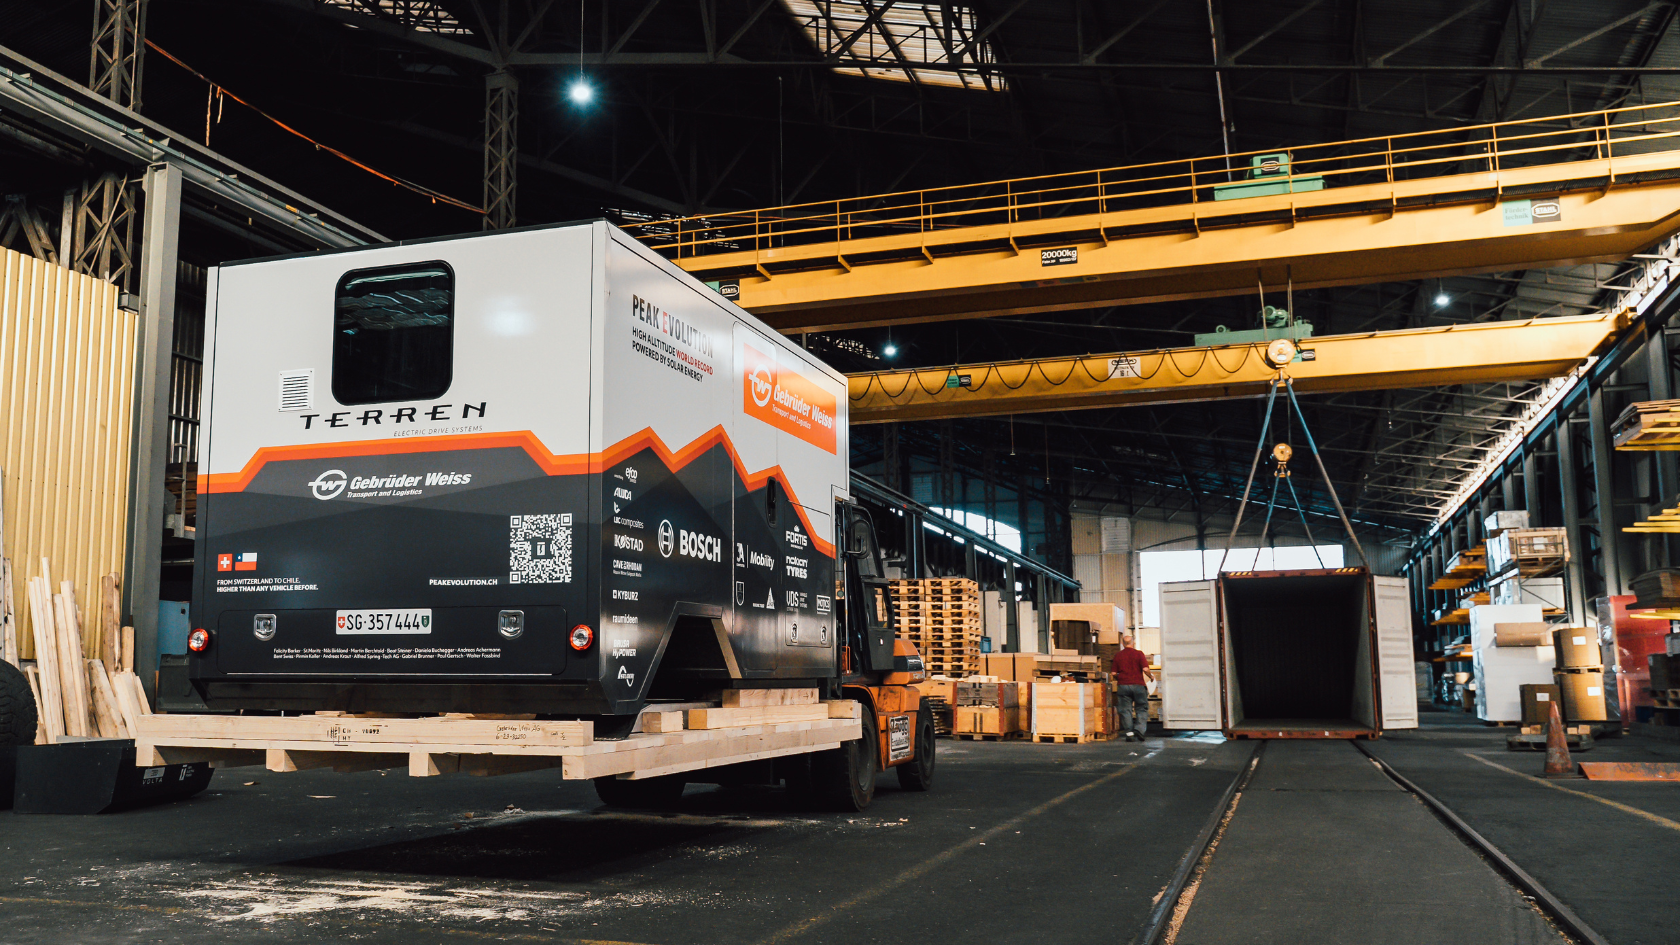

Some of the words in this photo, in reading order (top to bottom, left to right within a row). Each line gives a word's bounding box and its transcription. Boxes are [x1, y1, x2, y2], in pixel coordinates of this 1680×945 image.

[1534, 206, 1557, 214] STAHL
[1042, 249, 1077, 259] 20000kg
[632, 293, 659, 329] PEAK
[662, 311, 713, 358] EVOLUTION
[632, 326, 647, 342] HIGH
[647, 334, 676, 357] ALLTITUDE
[676, 348, 694, 366] WORLD
[694, 356, 714, 376] RECORD
[632, 340, 659, 361] POWERED
[659, 353, 667, 365] BY
[666, 357, 684, 374] SOLAR
[684, 366, 703, 382] ENERGY
[773, 384, 811, 417] Gebrüder
[811, 404, 833, 429] Weiss
[300, 401, 487, 430] TERREN
[772, 403, 789, 419] Transport
[789, 414, 797, 422] and
[796, 416, 812, 430] Logistics
[393, 429, 426, 437] ELECTRIC
[428, 427, 449, 435] DRIVE
[451, 425, 483, 434] SYSTEMS
[350, 474, 422, 490] Gebrüder
[424, 471, 472, 486] Weiss
[347, 490, 378, 499] Transport
[378, 489, 391, 497] and
[392, 488, 422, 497] Logistics
[680, 529, 721, 563] BOSCH
[785, 530, 808, 547] FORTIS
[750, 550, 775, 571] Mobility
[786, 565, 808, 579] TYRES
[429, 578, 498, 586] PEAKEVOLUTION.CH
[617, 590, 639, 601] KYBURZ
[785, 590, 799, 607] VDS
[612, 613, 639, 624] raumideen
